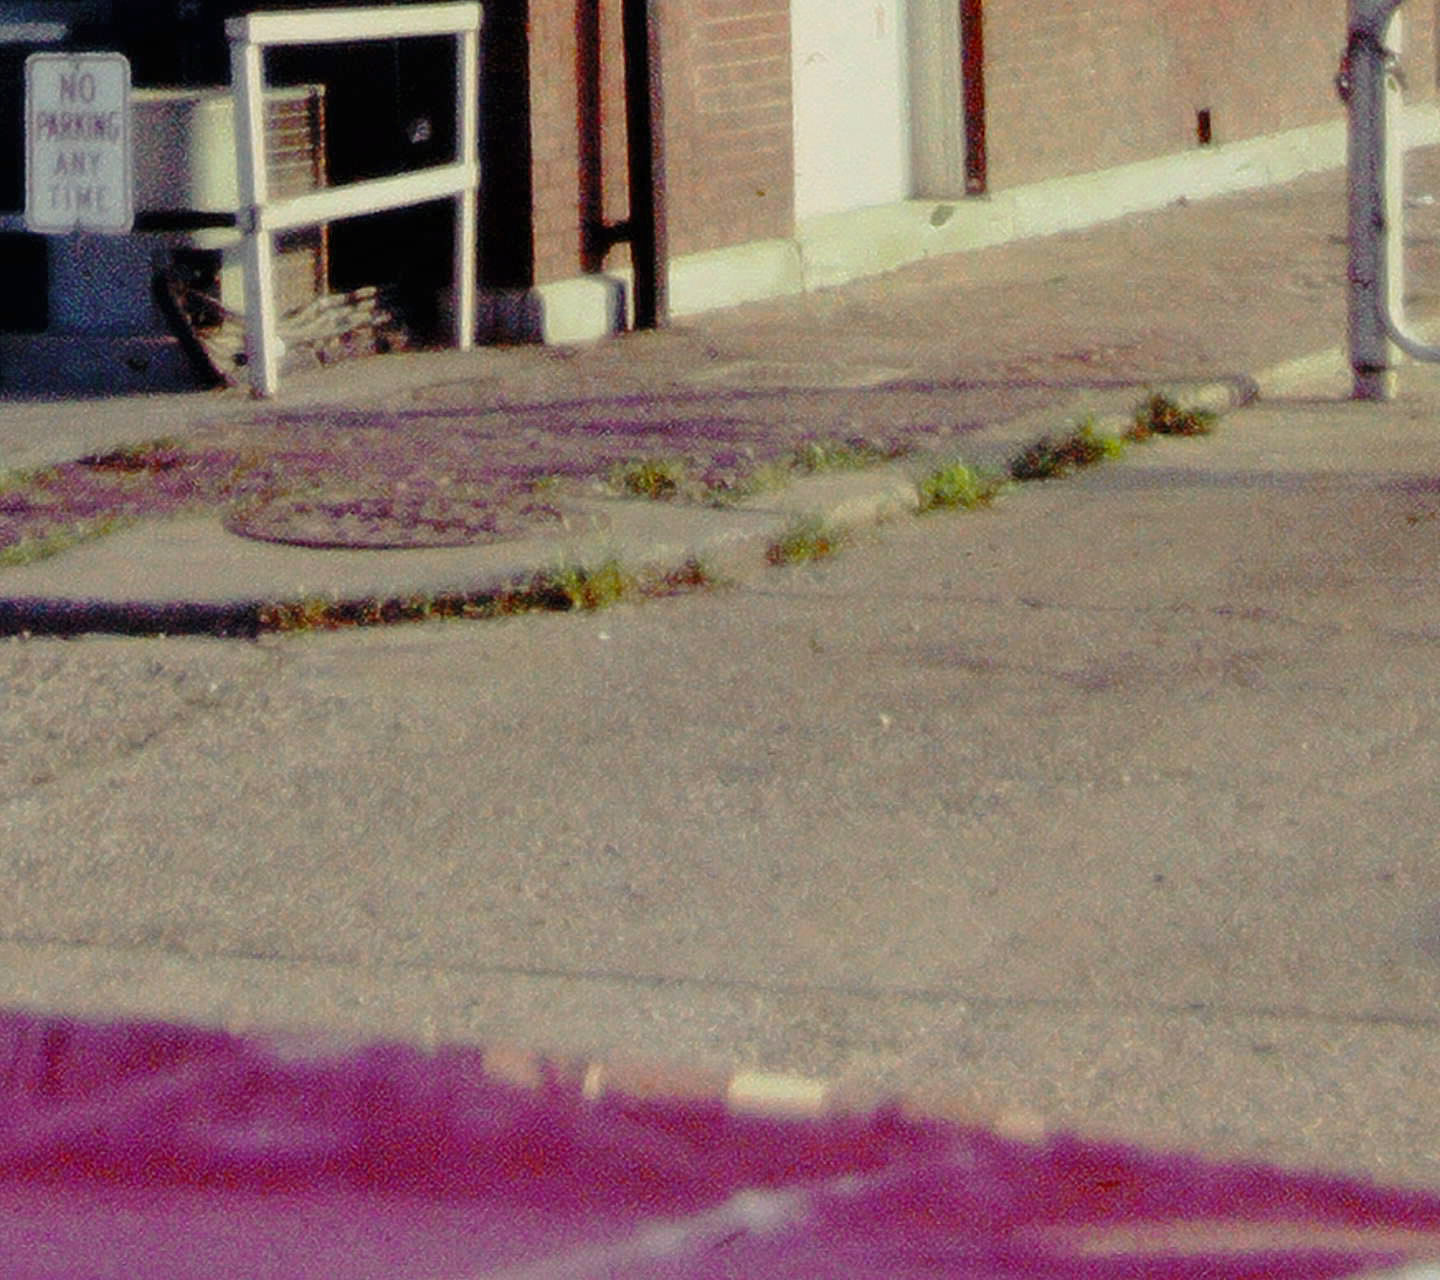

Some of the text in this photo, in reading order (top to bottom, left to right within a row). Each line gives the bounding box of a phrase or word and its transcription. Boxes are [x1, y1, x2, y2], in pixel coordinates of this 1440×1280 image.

[60, 72, 96, 103] NO
[36, 110, 122, 144] PARKING
[52, 150, 104, 176] ANY
[47, 182, 107, 212] TIME
